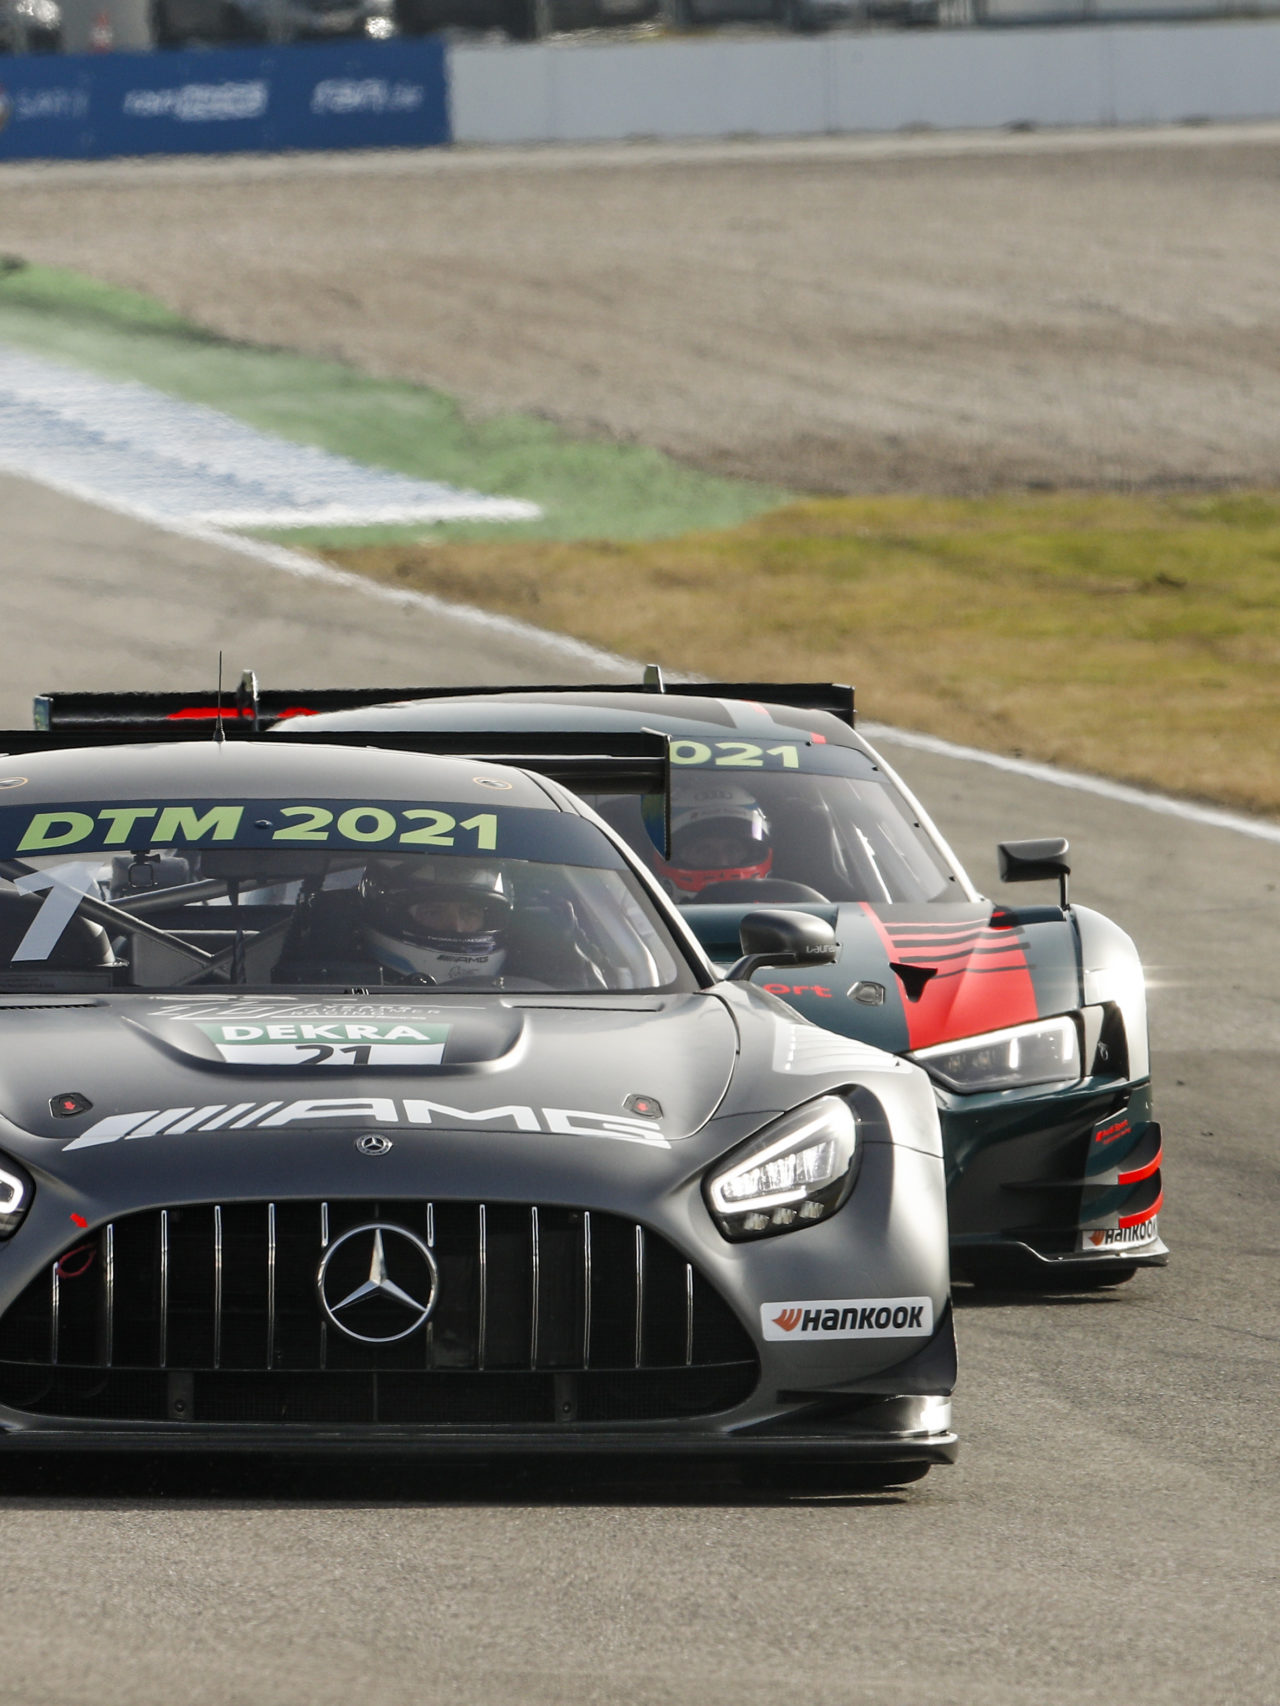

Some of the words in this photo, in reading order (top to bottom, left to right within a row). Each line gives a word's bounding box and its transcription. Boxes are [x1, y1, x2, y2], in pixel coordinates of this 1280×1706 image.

[16, 806, 244, 851] DTM
[272, 806, 498, 850] 2021
[221, 1024, 431, 1042] DEKRA
[295, 1044, 373, 1065] 21
[258, 1097, 672, 1150] AMG
